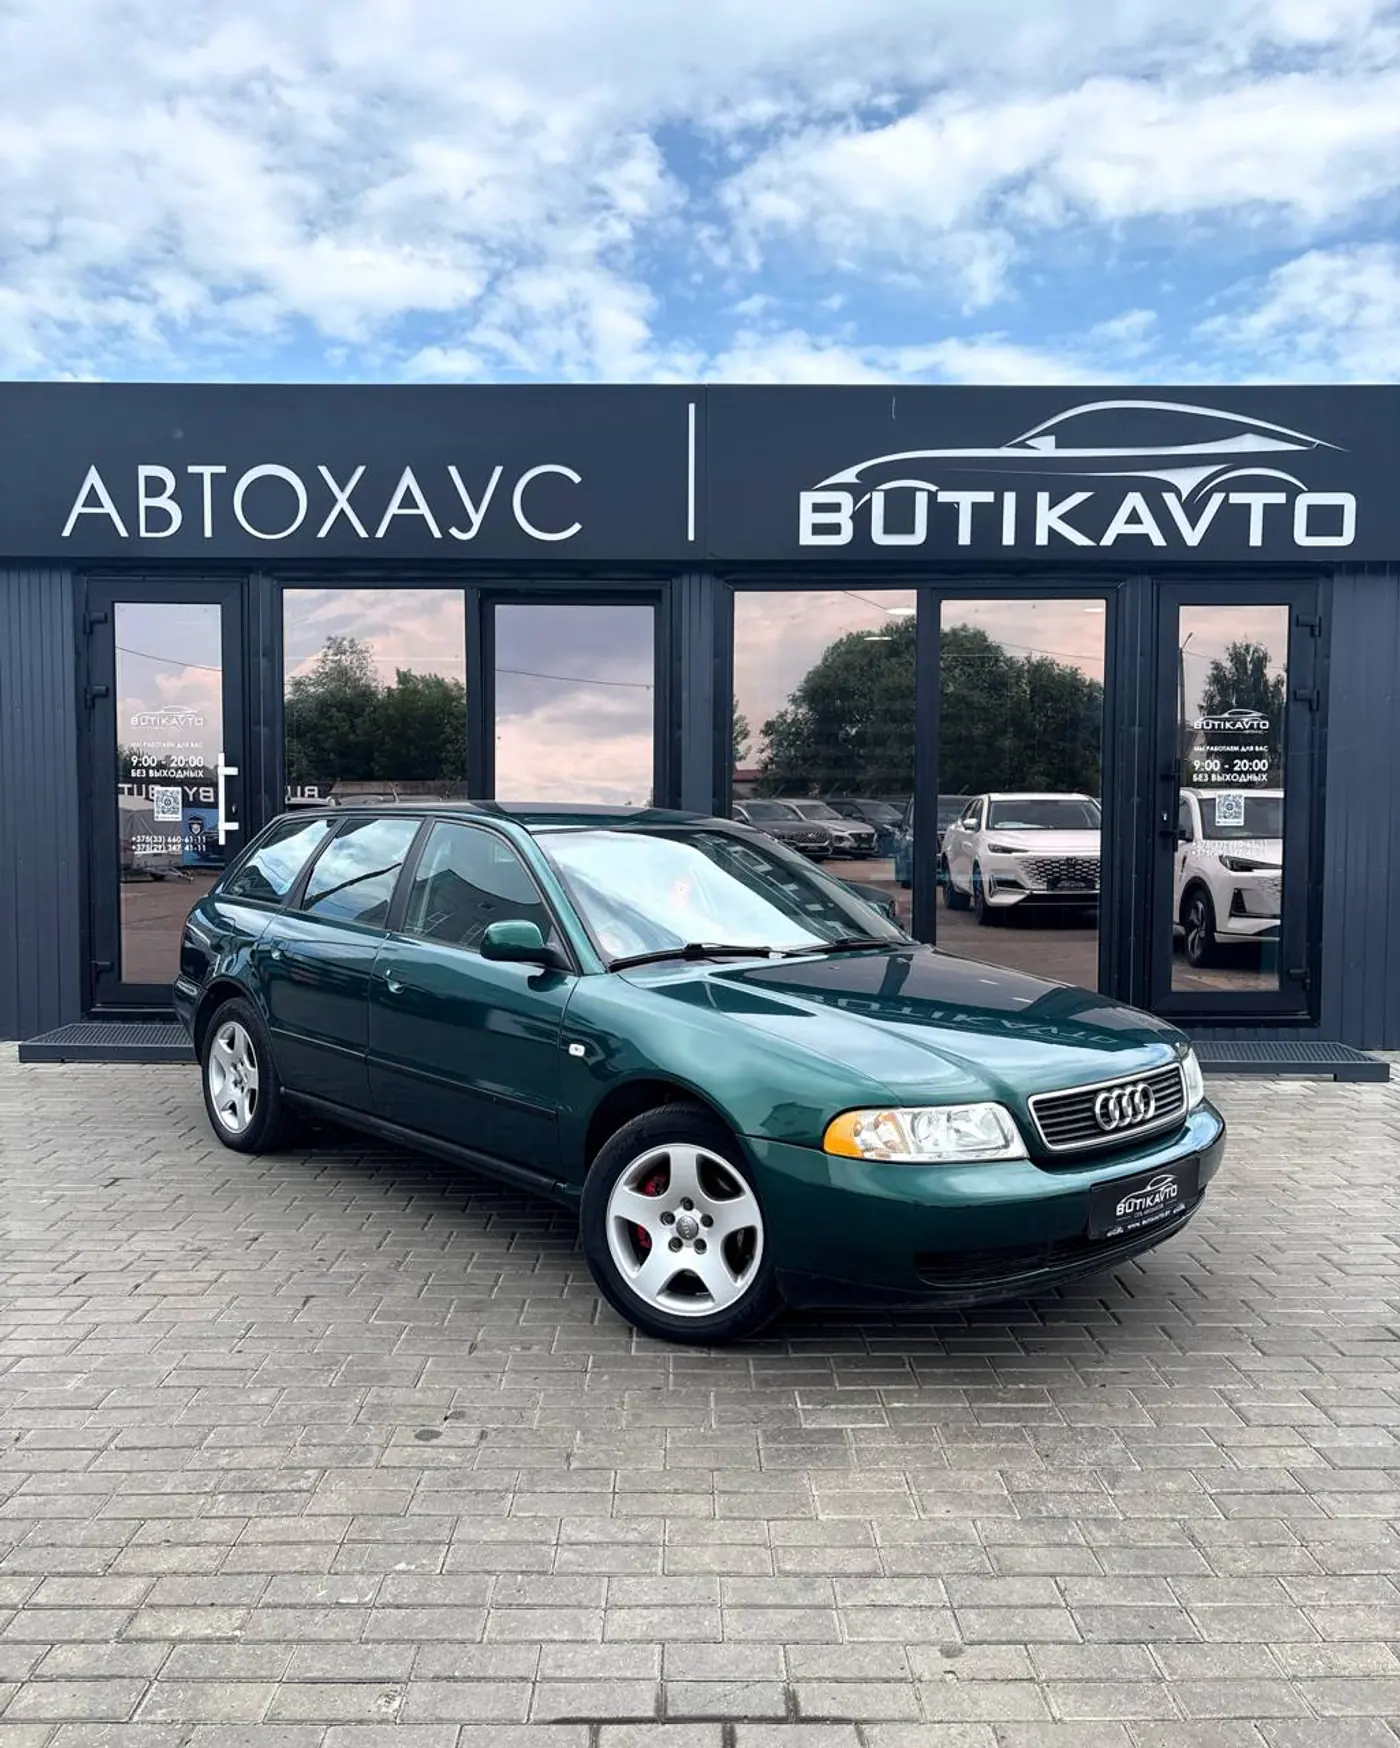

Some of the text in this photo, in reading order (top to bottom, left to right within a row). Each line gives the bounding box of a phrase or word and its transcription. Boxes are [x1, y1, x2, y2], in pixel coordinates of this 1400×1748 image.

[61, 463, 583, 541] АВТОХАУС
[800, 491, 1356, 547] BUTIKAVTO
[131, 715, 204, 727] BUTIKAVTO
[1193, 720, 1269, 730] BUTIKAVTO
[1240, 745, 1254, 753] ДЛЯ
[131, 755, 157, 767] 9:00
[170, 755, 204, 767] 20:00
[1193, 759, 1221, 772] 9:00
[1233, 759, 1269, 772] 20:00
[131, 768, 204, 778] БЕЗ ВЫХОДНЫХ
[1192, 773, 1268, 783] БЕЗ ВЫХОДНЫХ
[1116, 1185, 1178, 1216] BUTIKAVTO
